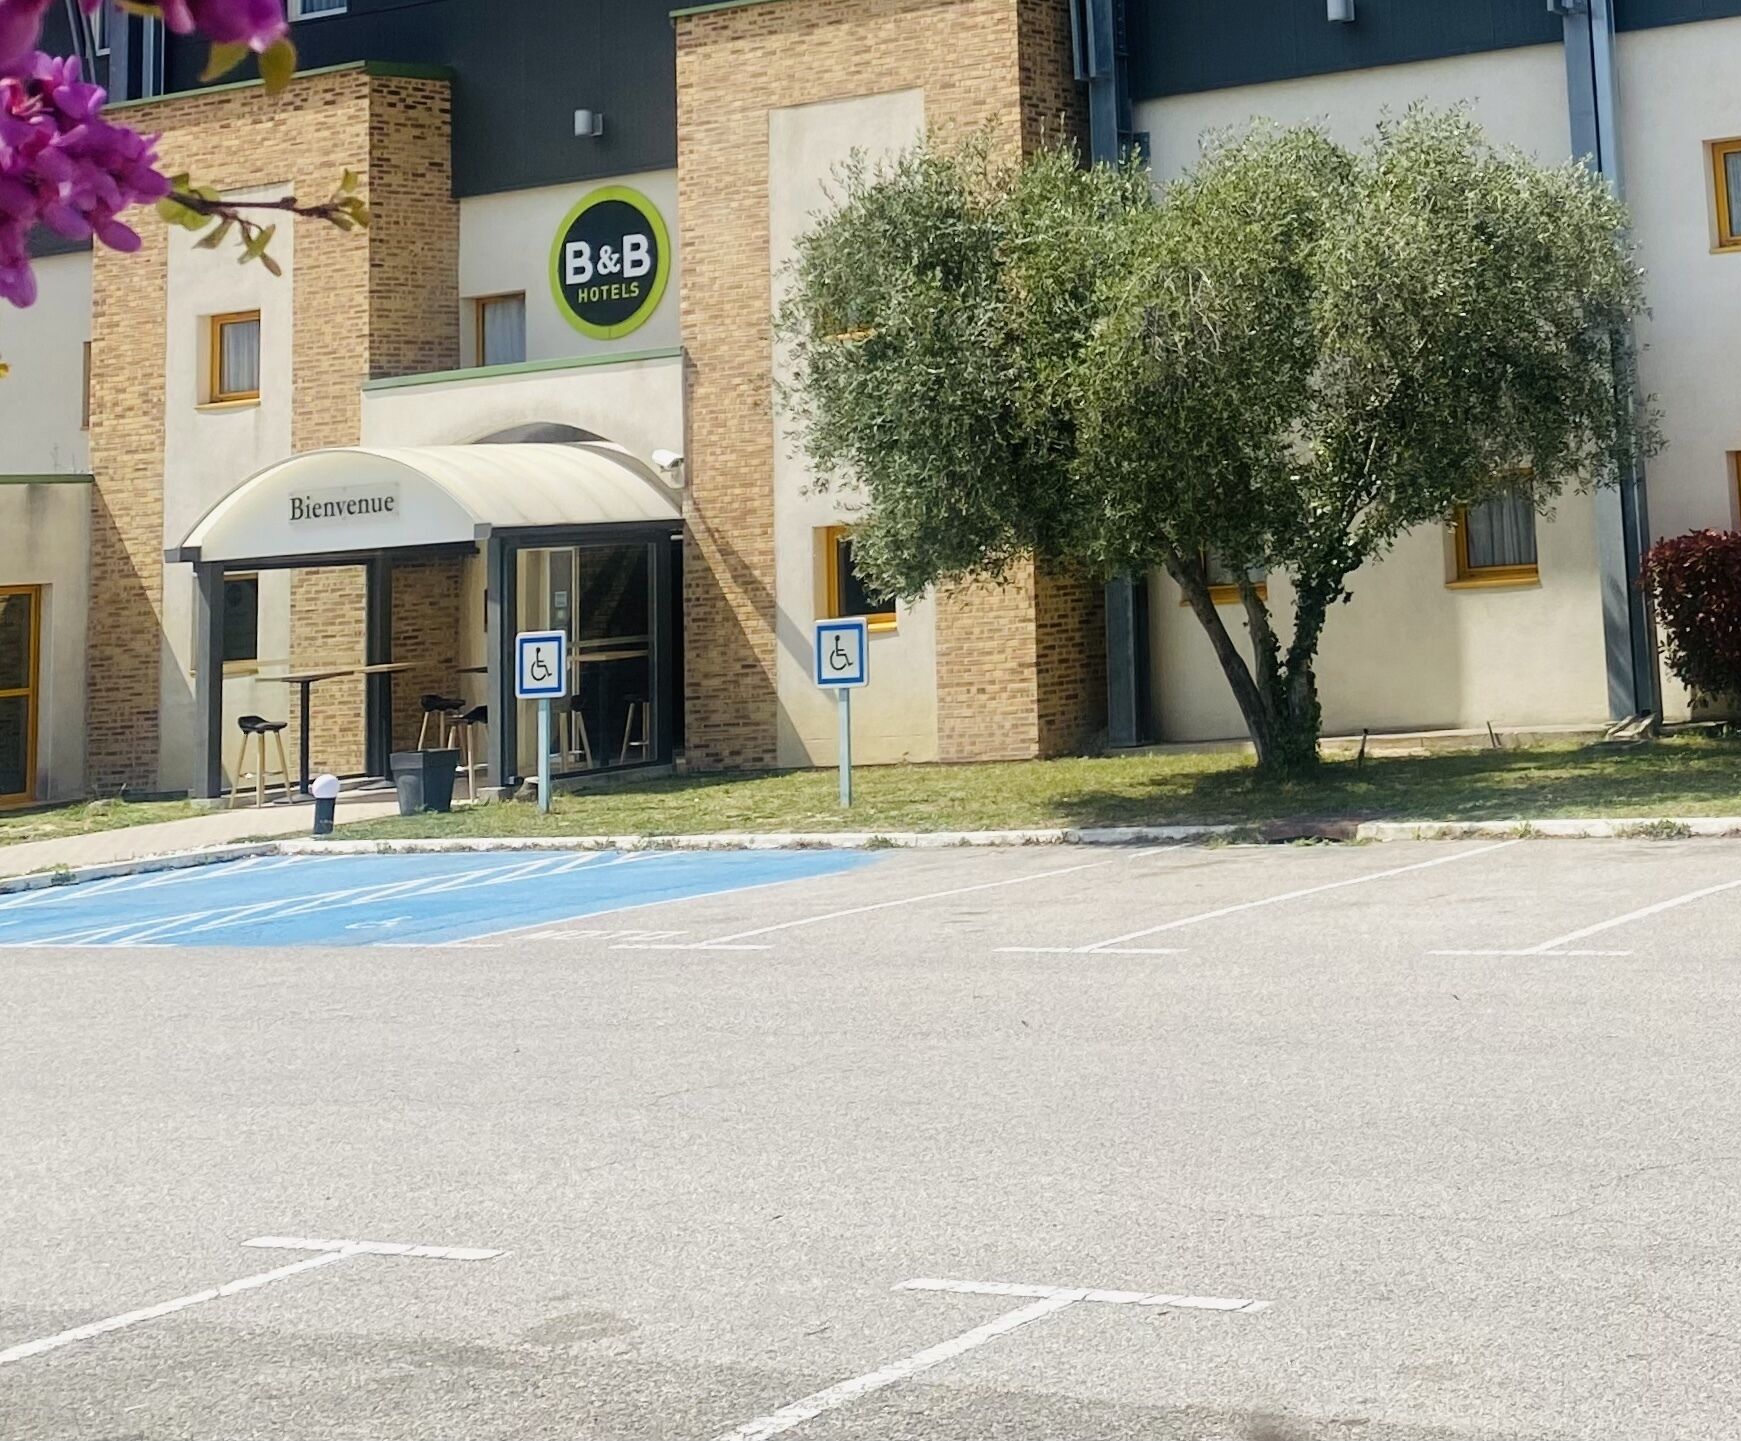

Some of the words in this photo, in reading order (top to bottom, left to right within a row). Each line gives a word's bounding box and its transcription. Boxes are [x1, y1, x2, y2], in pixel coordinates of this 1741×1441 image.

[565, 233, 651, 285] B&B
[578, 281, 640, 303] HOTELS
[289, 495, 395, 521] Bienvenue
